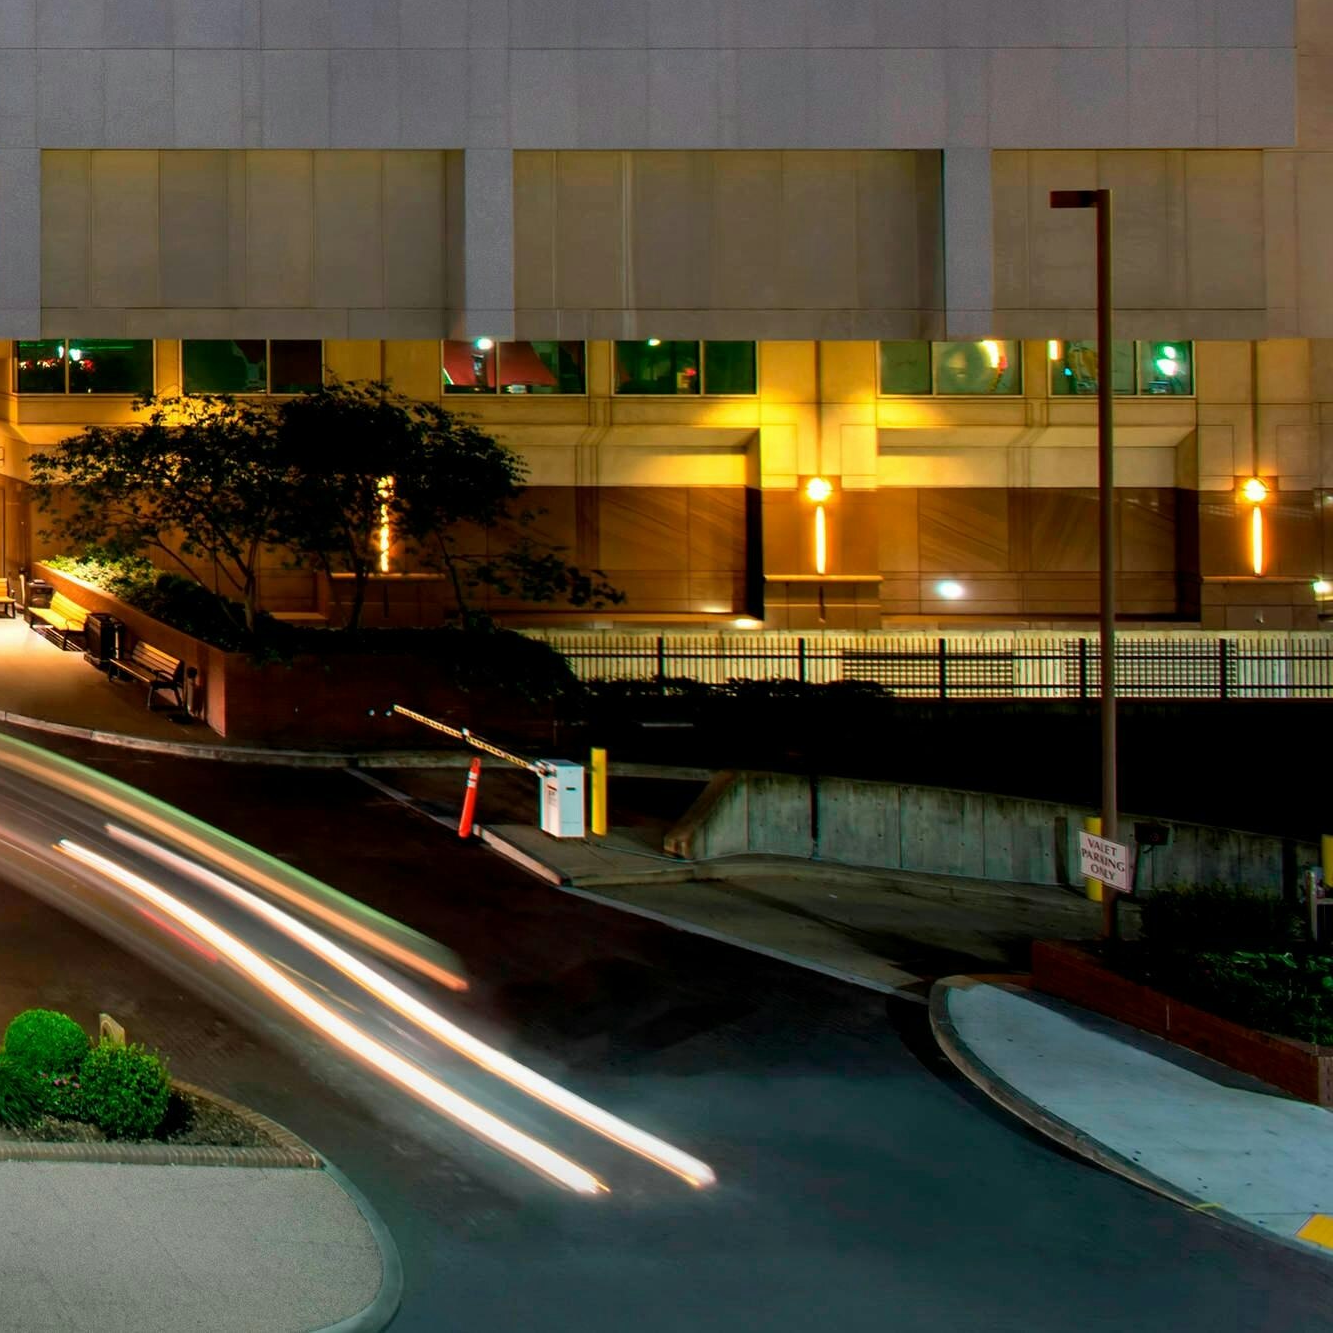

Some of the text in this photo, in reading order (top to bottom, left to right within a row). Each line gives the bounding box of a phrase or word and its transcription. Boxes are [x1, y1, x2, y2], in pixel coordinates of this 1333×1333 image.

[1088, 838, 1117, 856] VALET
[1081, 848, 1125, 872] PARKING
[1090, 864, 1115, 880] ONLY
